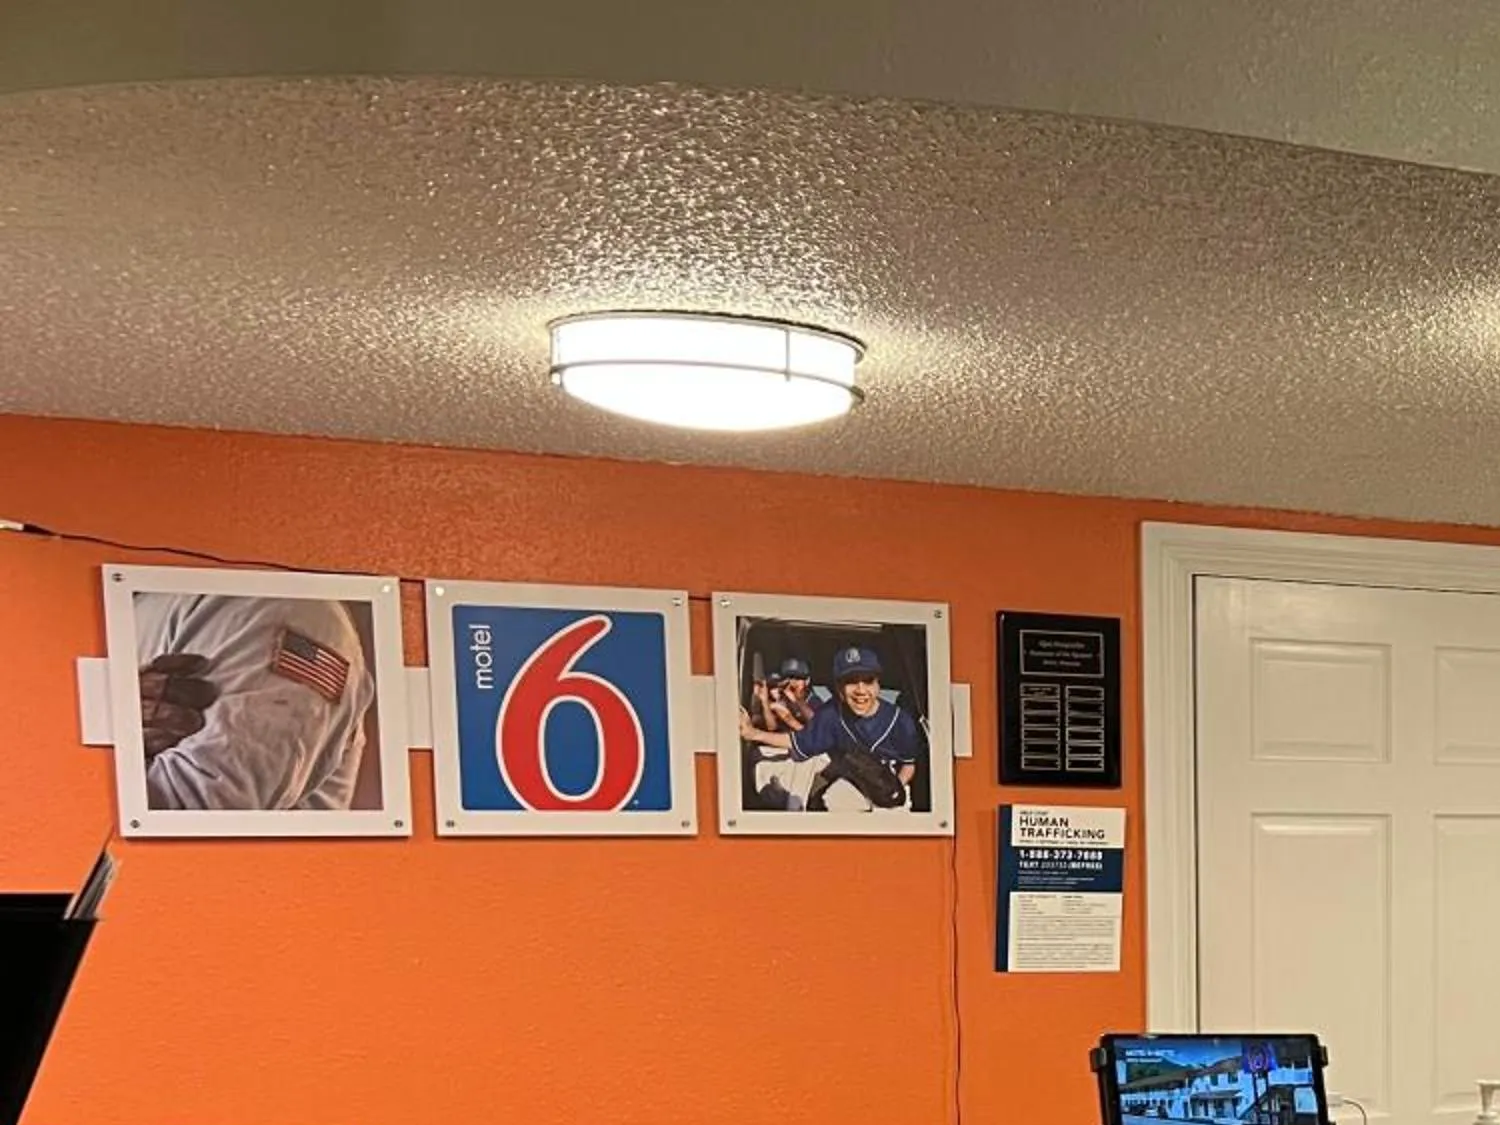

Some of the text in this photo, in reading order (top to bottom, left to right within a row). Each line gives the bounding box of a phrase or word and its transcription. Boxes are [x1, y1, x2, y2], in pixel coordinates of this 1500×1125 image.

[469, 624, 493, 689] motel
[496, 614, 645, 813] 6
[1019, 816, 1069, 828] HUMAN
[1020, 827, 1105, 840] TRAFFICKING
